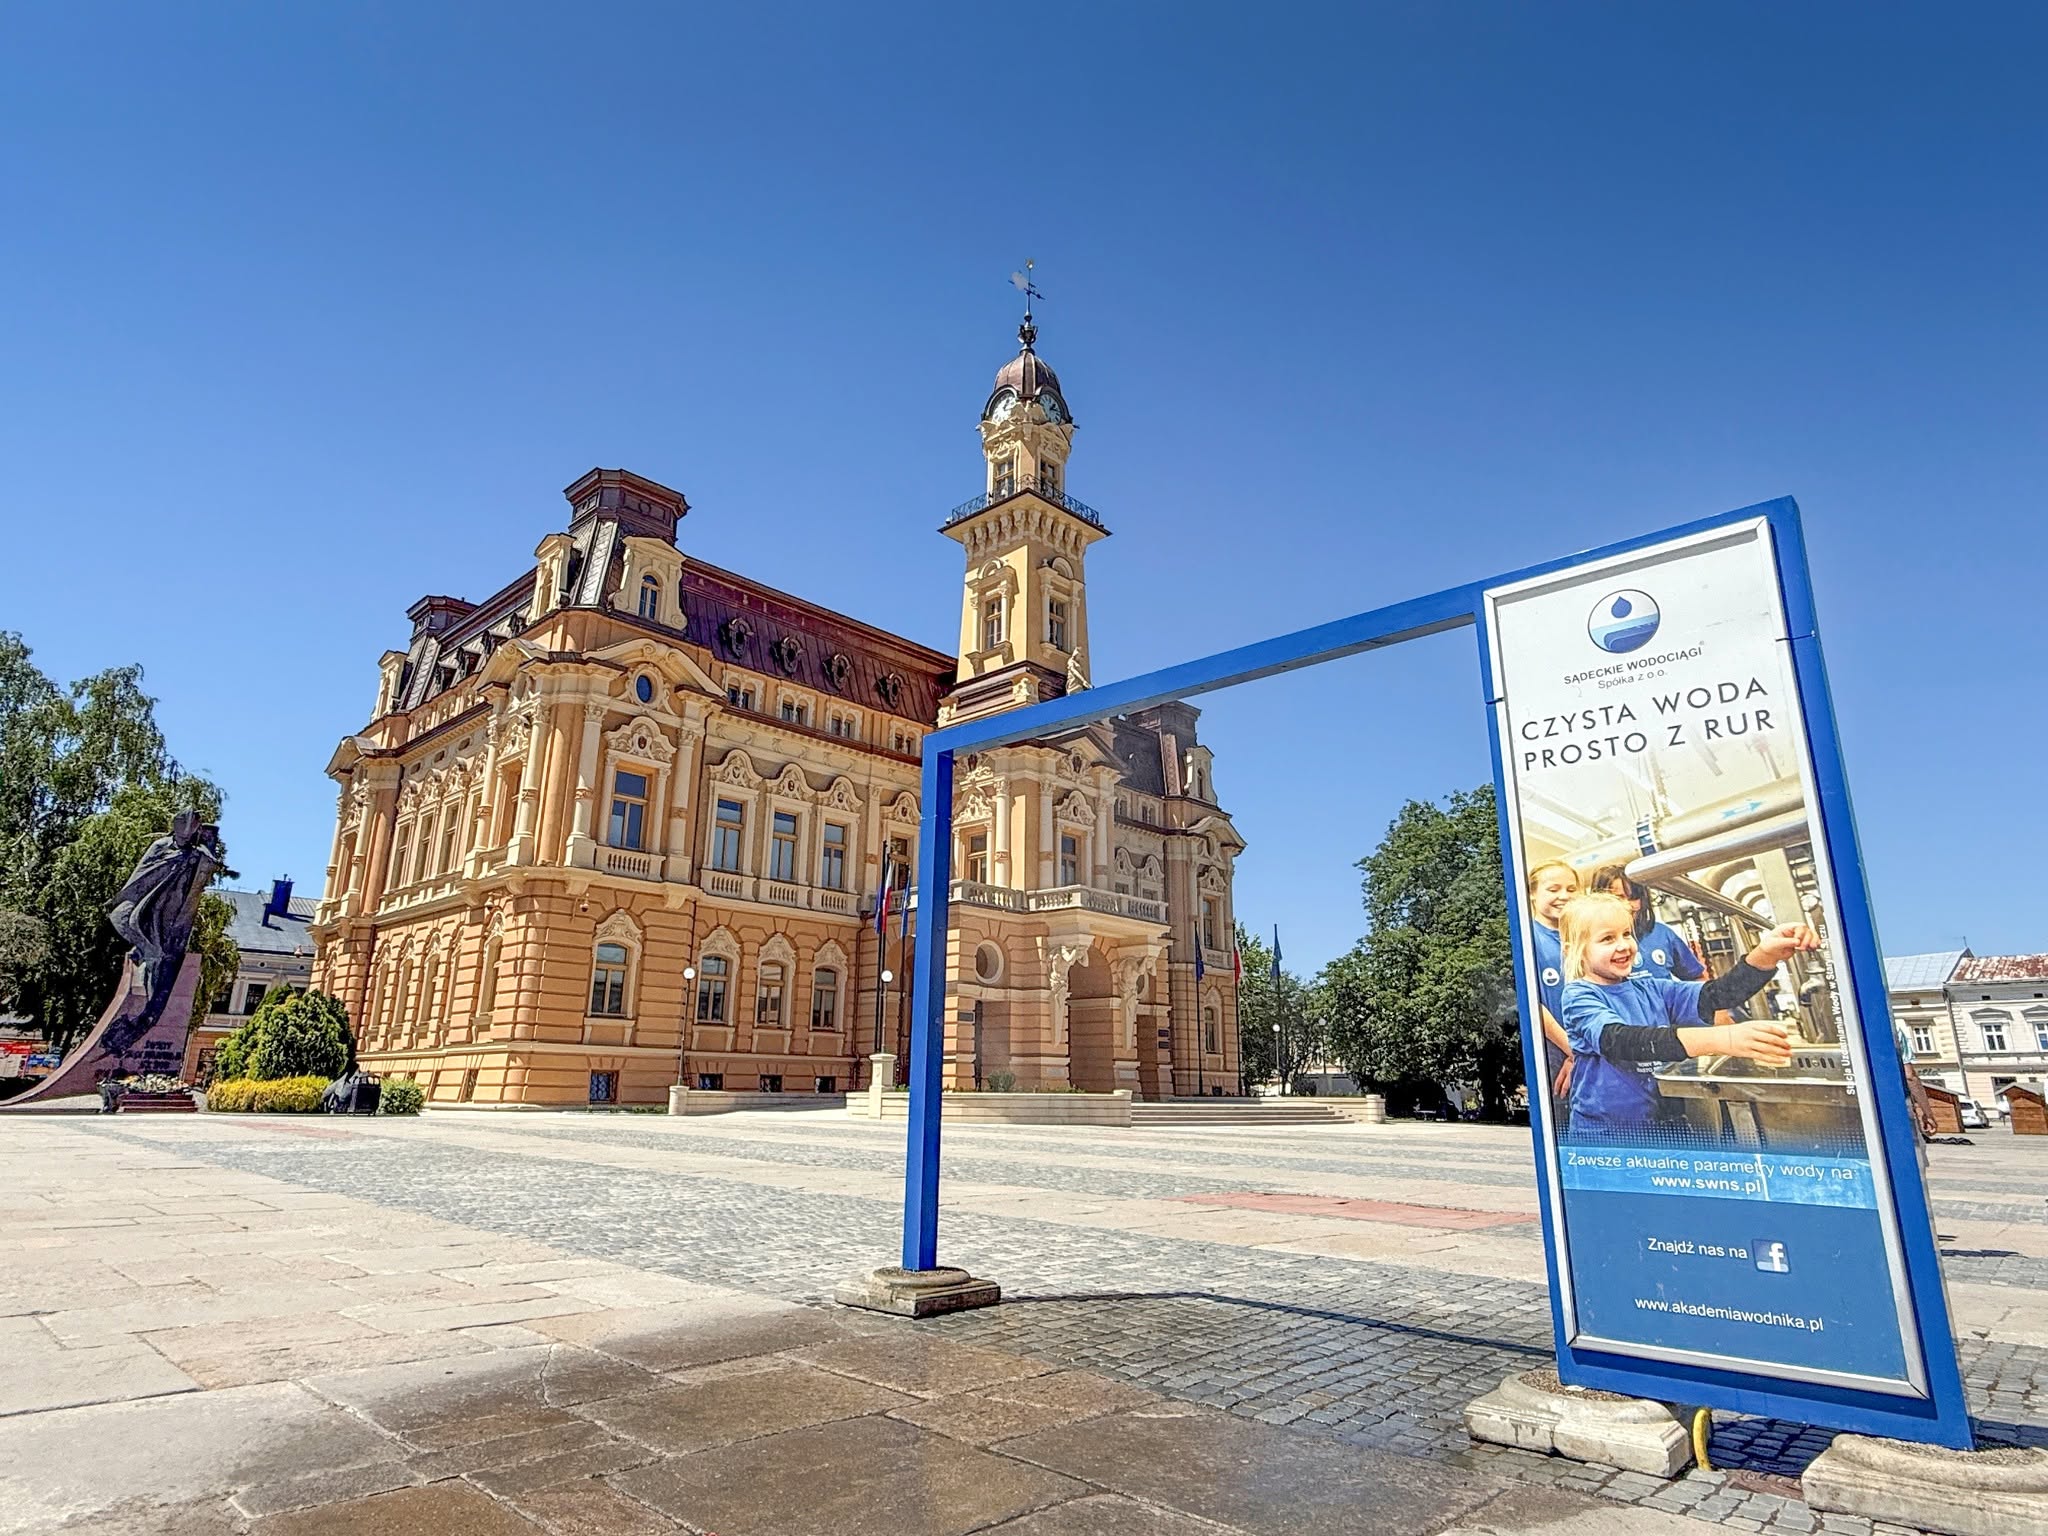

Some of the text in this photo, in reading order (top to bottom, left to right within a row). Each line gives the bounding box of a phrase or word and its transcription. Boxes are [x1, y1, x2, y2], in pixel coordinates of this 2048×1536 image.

[1564, 646, 1702, 685] SĄDECKIE WODOCIĄGI
[1597, 674, 1635, 689] Spółka
[1638, 673, 1644, 681] z
[1521, 677, 1768, 741] CZYSTA WODA
[1524, 709, 1775, 771] PROSTO Z RUR
[1829, 990, 1841, 1015] Wody
[1843, 1068, 1856, 1095] Stcja
[1567, 1152, 1622, 1168] Zawsze
[1626, 1155, 1690, 1171] aktualne
[1779, 1163, 1825, 1181] wody
[1651, 1175, 1762, 1195] www.swns.pl
[1698, 1243, 1725, 1257] nas
[1729, 1247, 1748, 1259] na
[1635, 1298, 1824, 1333] www.akademiawodnika.pl
